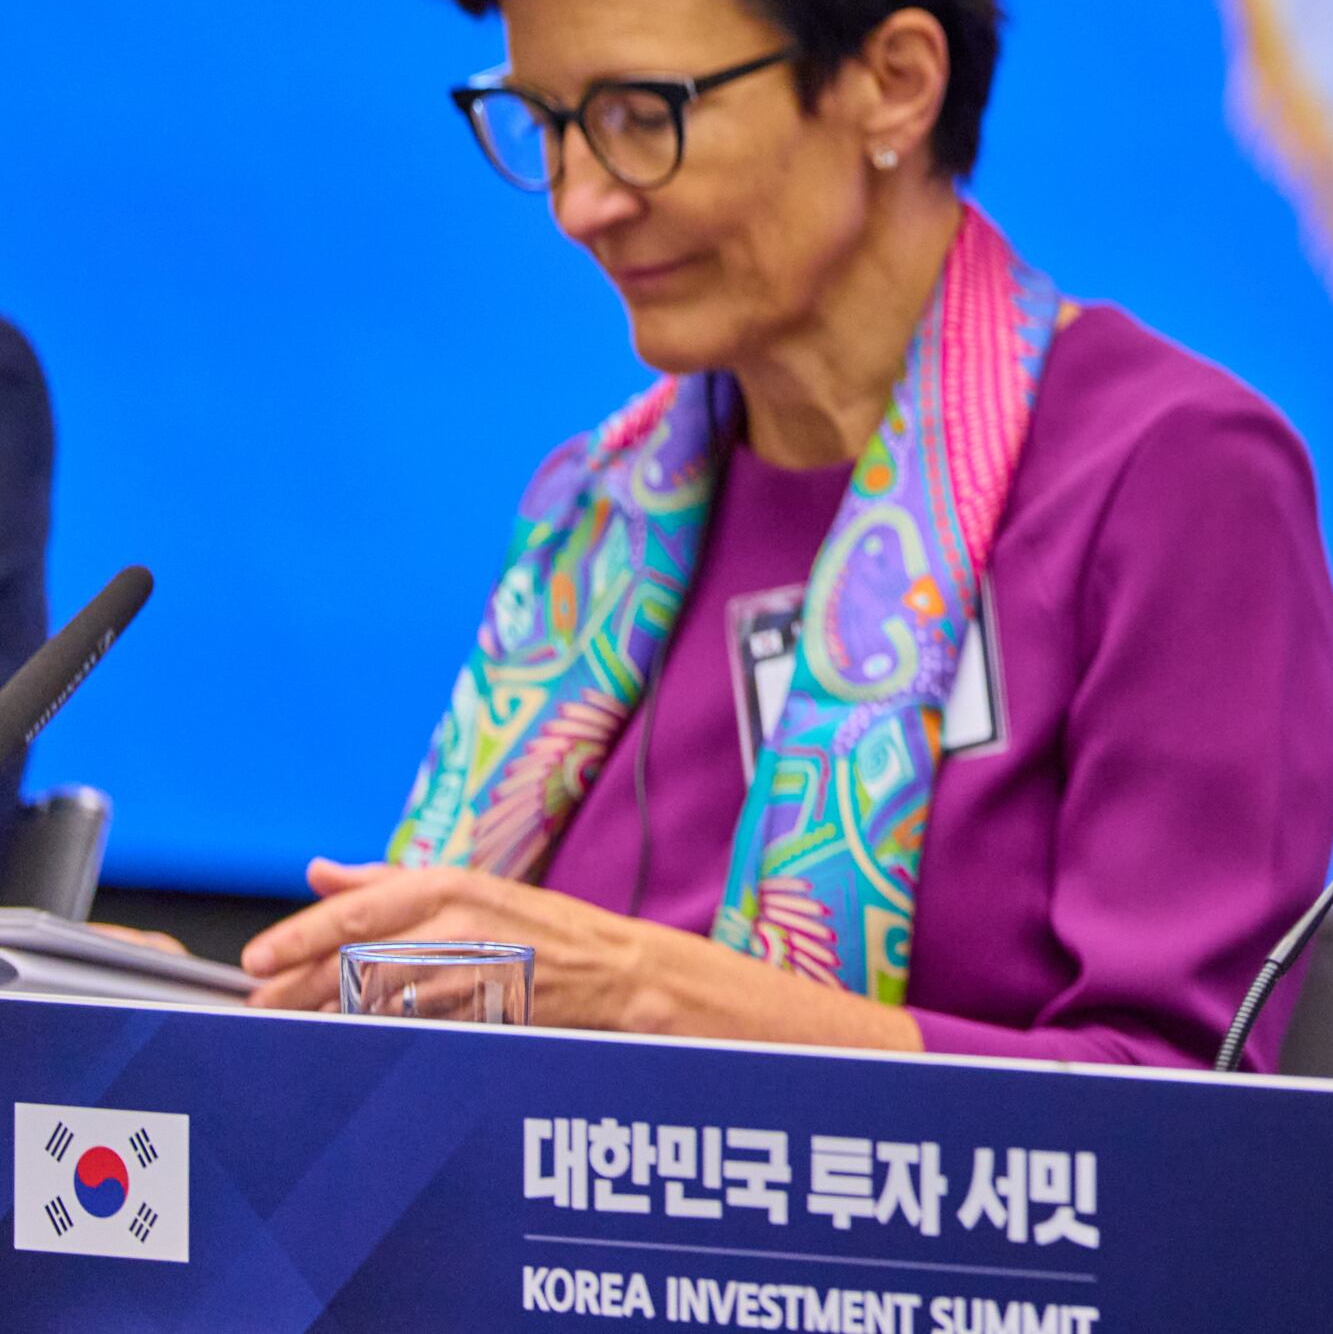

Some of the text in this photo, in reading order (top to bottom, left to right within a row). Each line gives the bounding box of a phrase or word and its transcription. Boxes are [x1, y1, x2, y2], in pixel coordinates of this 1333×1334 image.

[523, 1117, 1100, 1249] 대한민국 투자 서밋
[522, 1266, 1100, 1334] KOREA INVESTMENT SUMMIT
